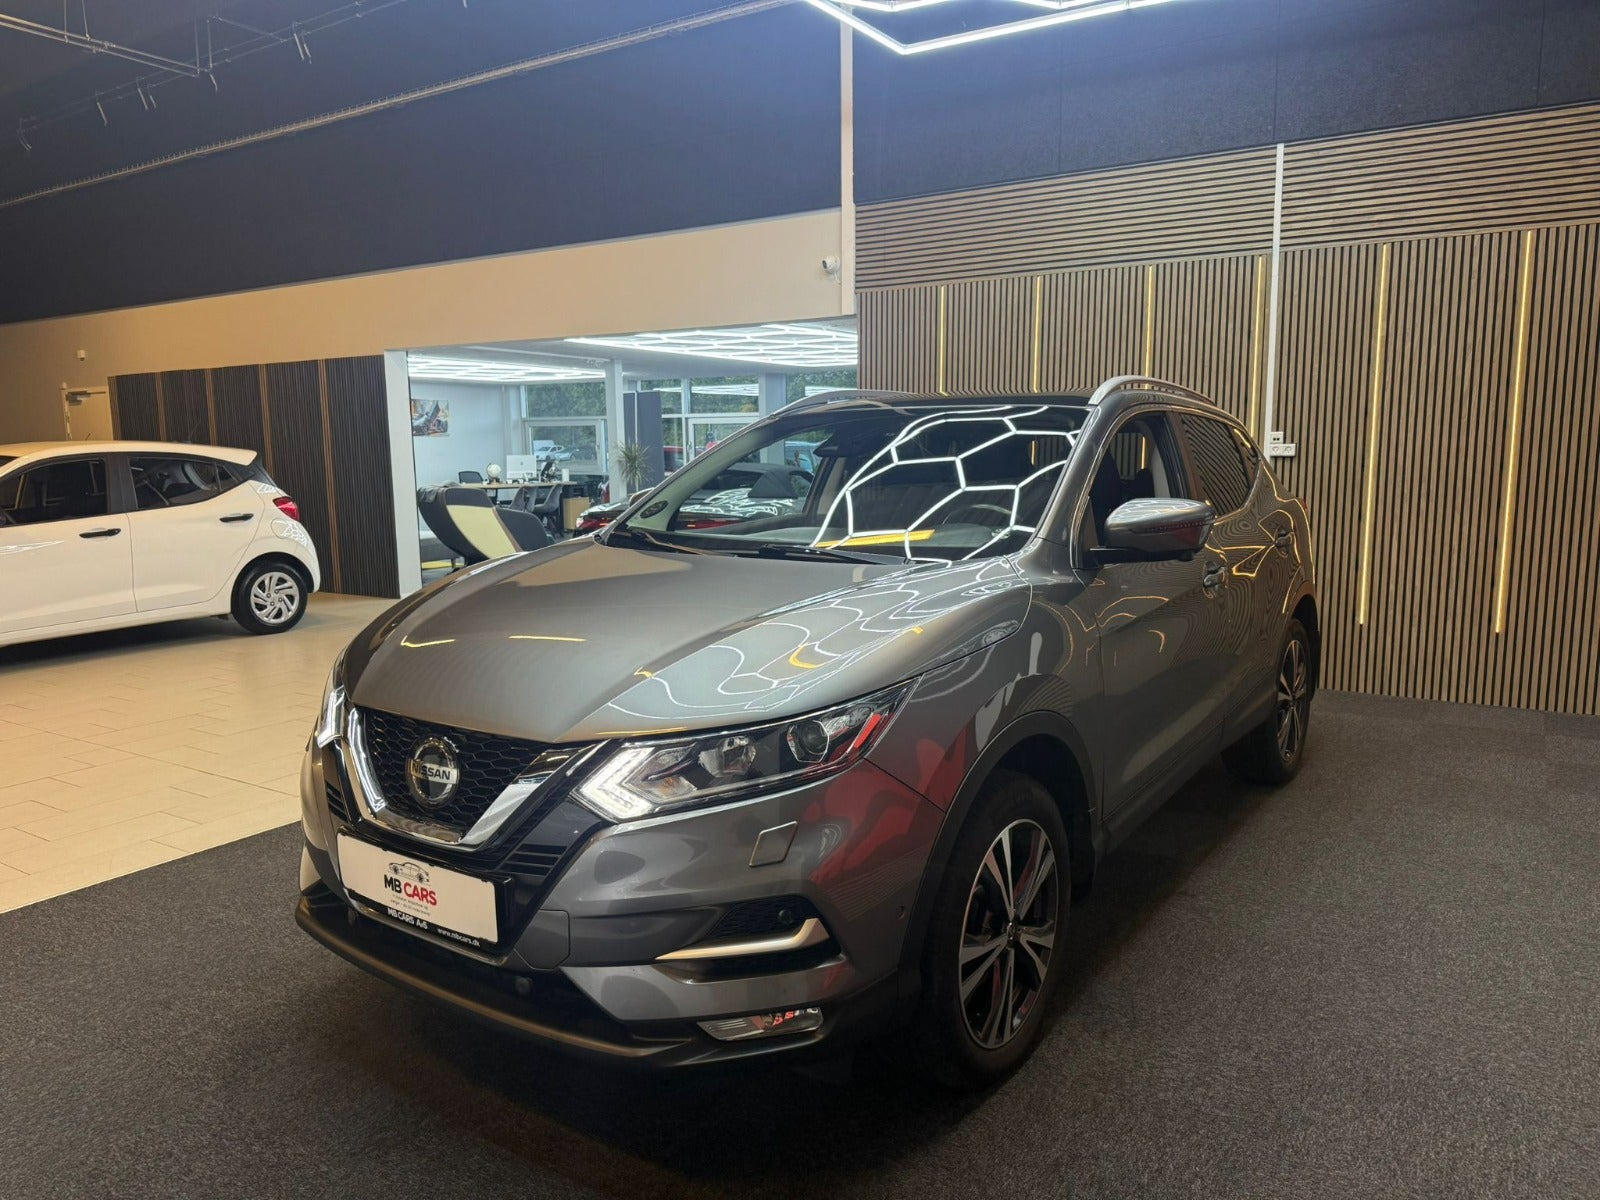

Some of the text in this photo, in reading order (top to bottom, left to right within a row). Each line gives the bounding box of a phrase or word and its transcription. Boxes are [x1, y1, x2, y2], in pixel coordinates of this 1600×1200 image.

[384, 875, 402, 894] MB
[404, 882, 437, 906] CARS
[398, 912, 415, 924] CARS
